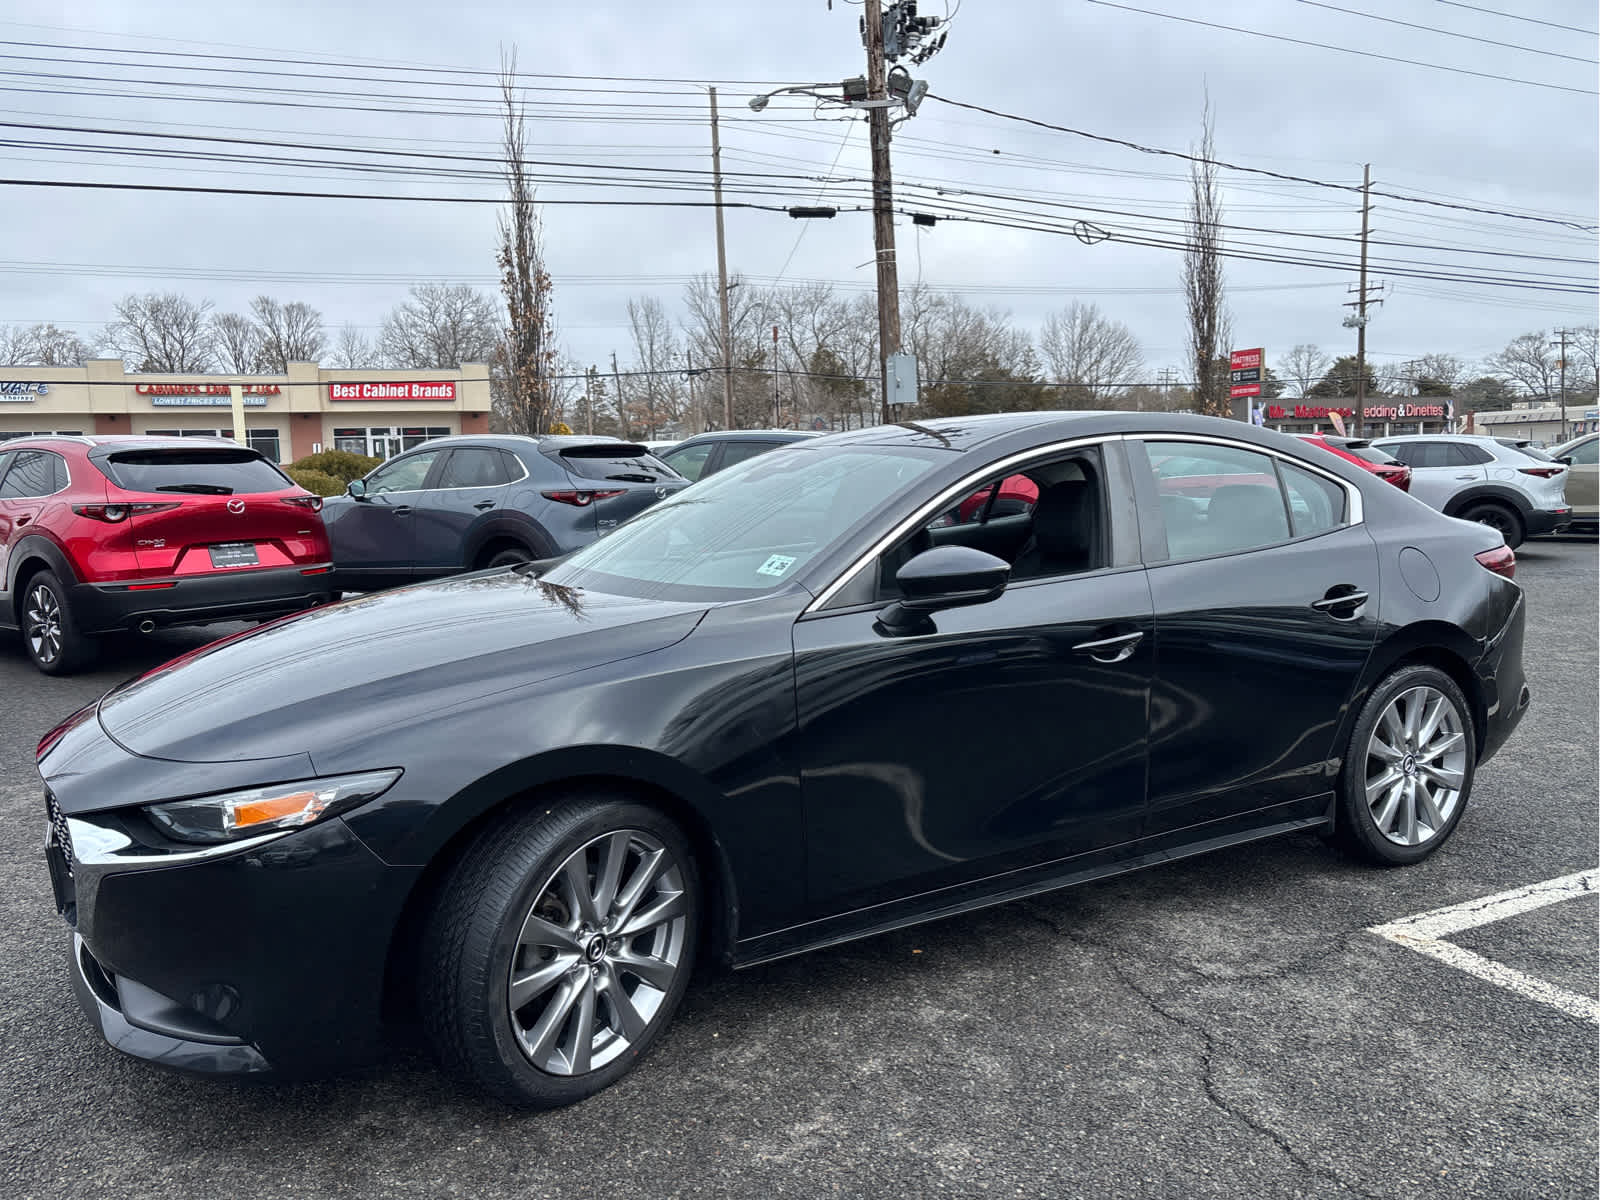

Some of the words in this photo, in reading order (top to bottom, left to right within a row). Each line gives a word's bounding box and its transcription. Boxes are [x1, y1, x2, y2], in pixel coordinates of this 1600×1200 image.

[333, 384, 360, 397] Best
[363, 384, 409, 397] Cabinet
[412, 384, 452, 397] Brands
[1364, 405, 1397, 420] edding
[1398, 404, 1405, 416] &
[1406, 404, 1444, 416] Dinettes
